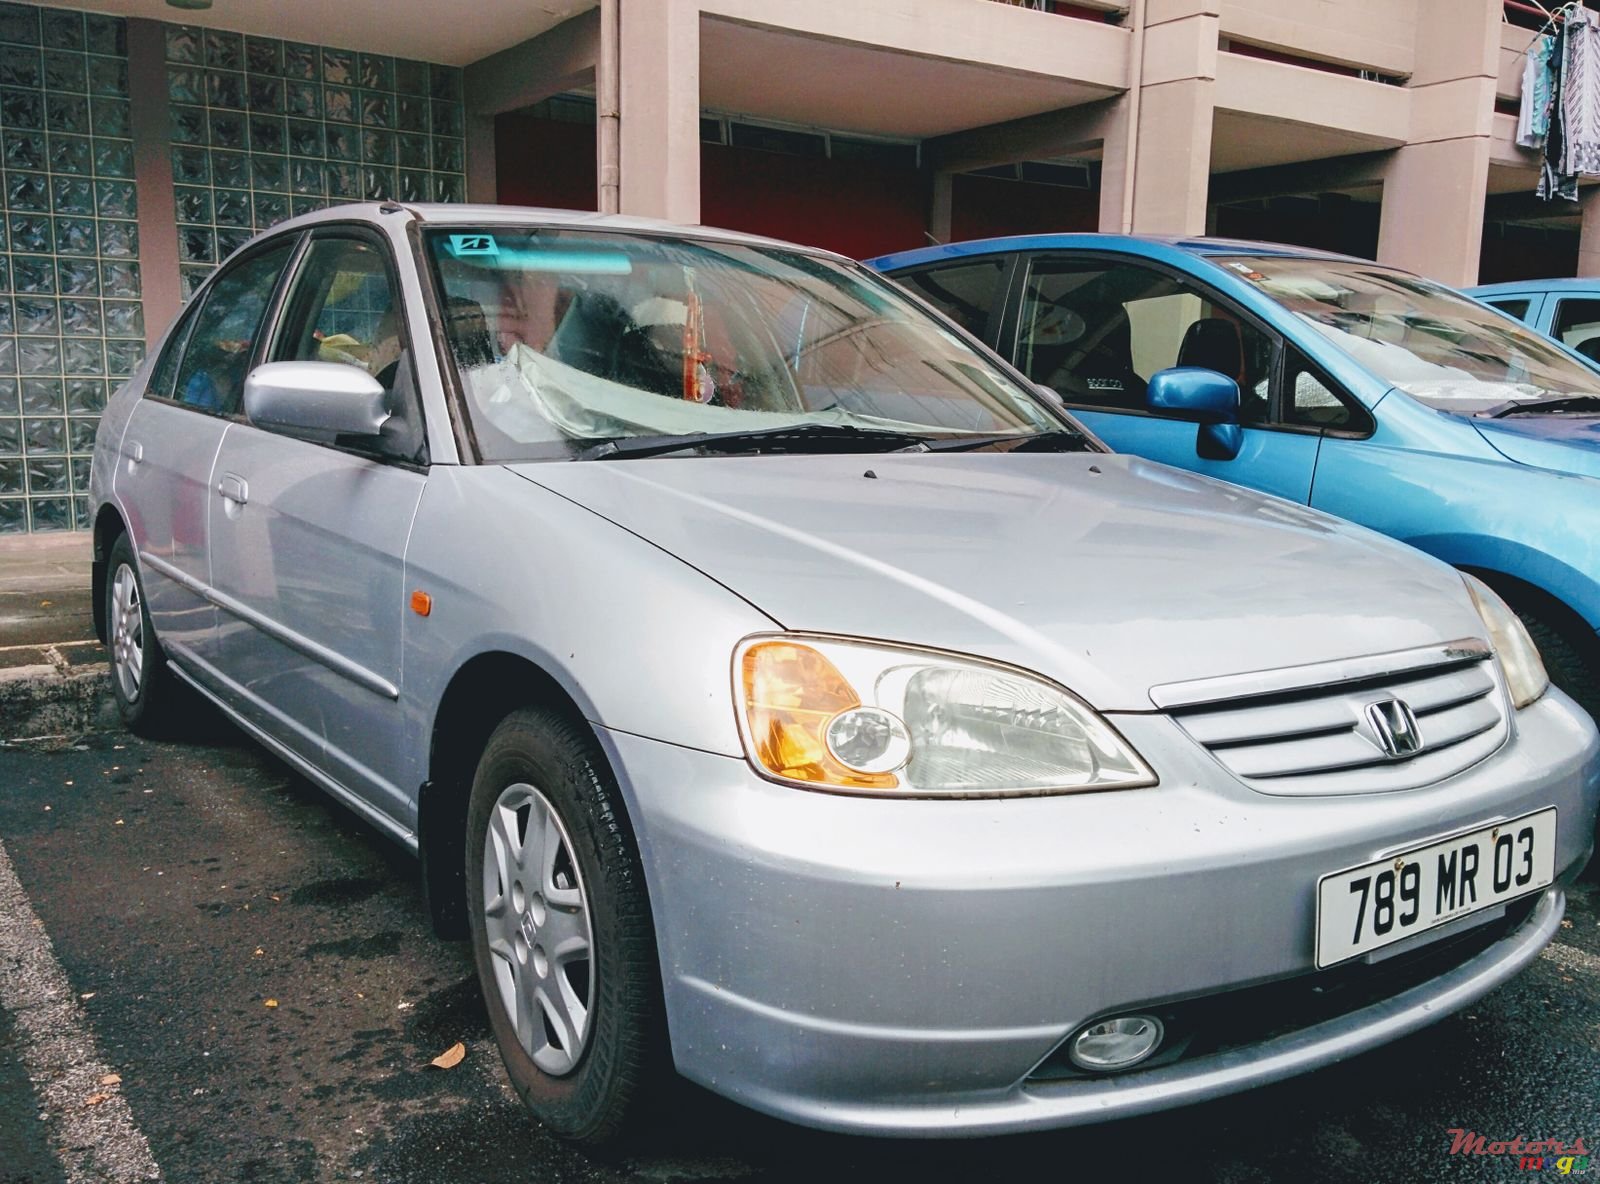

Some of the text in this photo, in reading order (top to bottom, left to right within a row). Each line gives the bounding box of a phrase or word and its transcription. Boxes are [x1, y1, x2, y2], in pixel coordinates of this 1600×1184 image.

[1350, 826, 1534, 945] 789 MR 03
